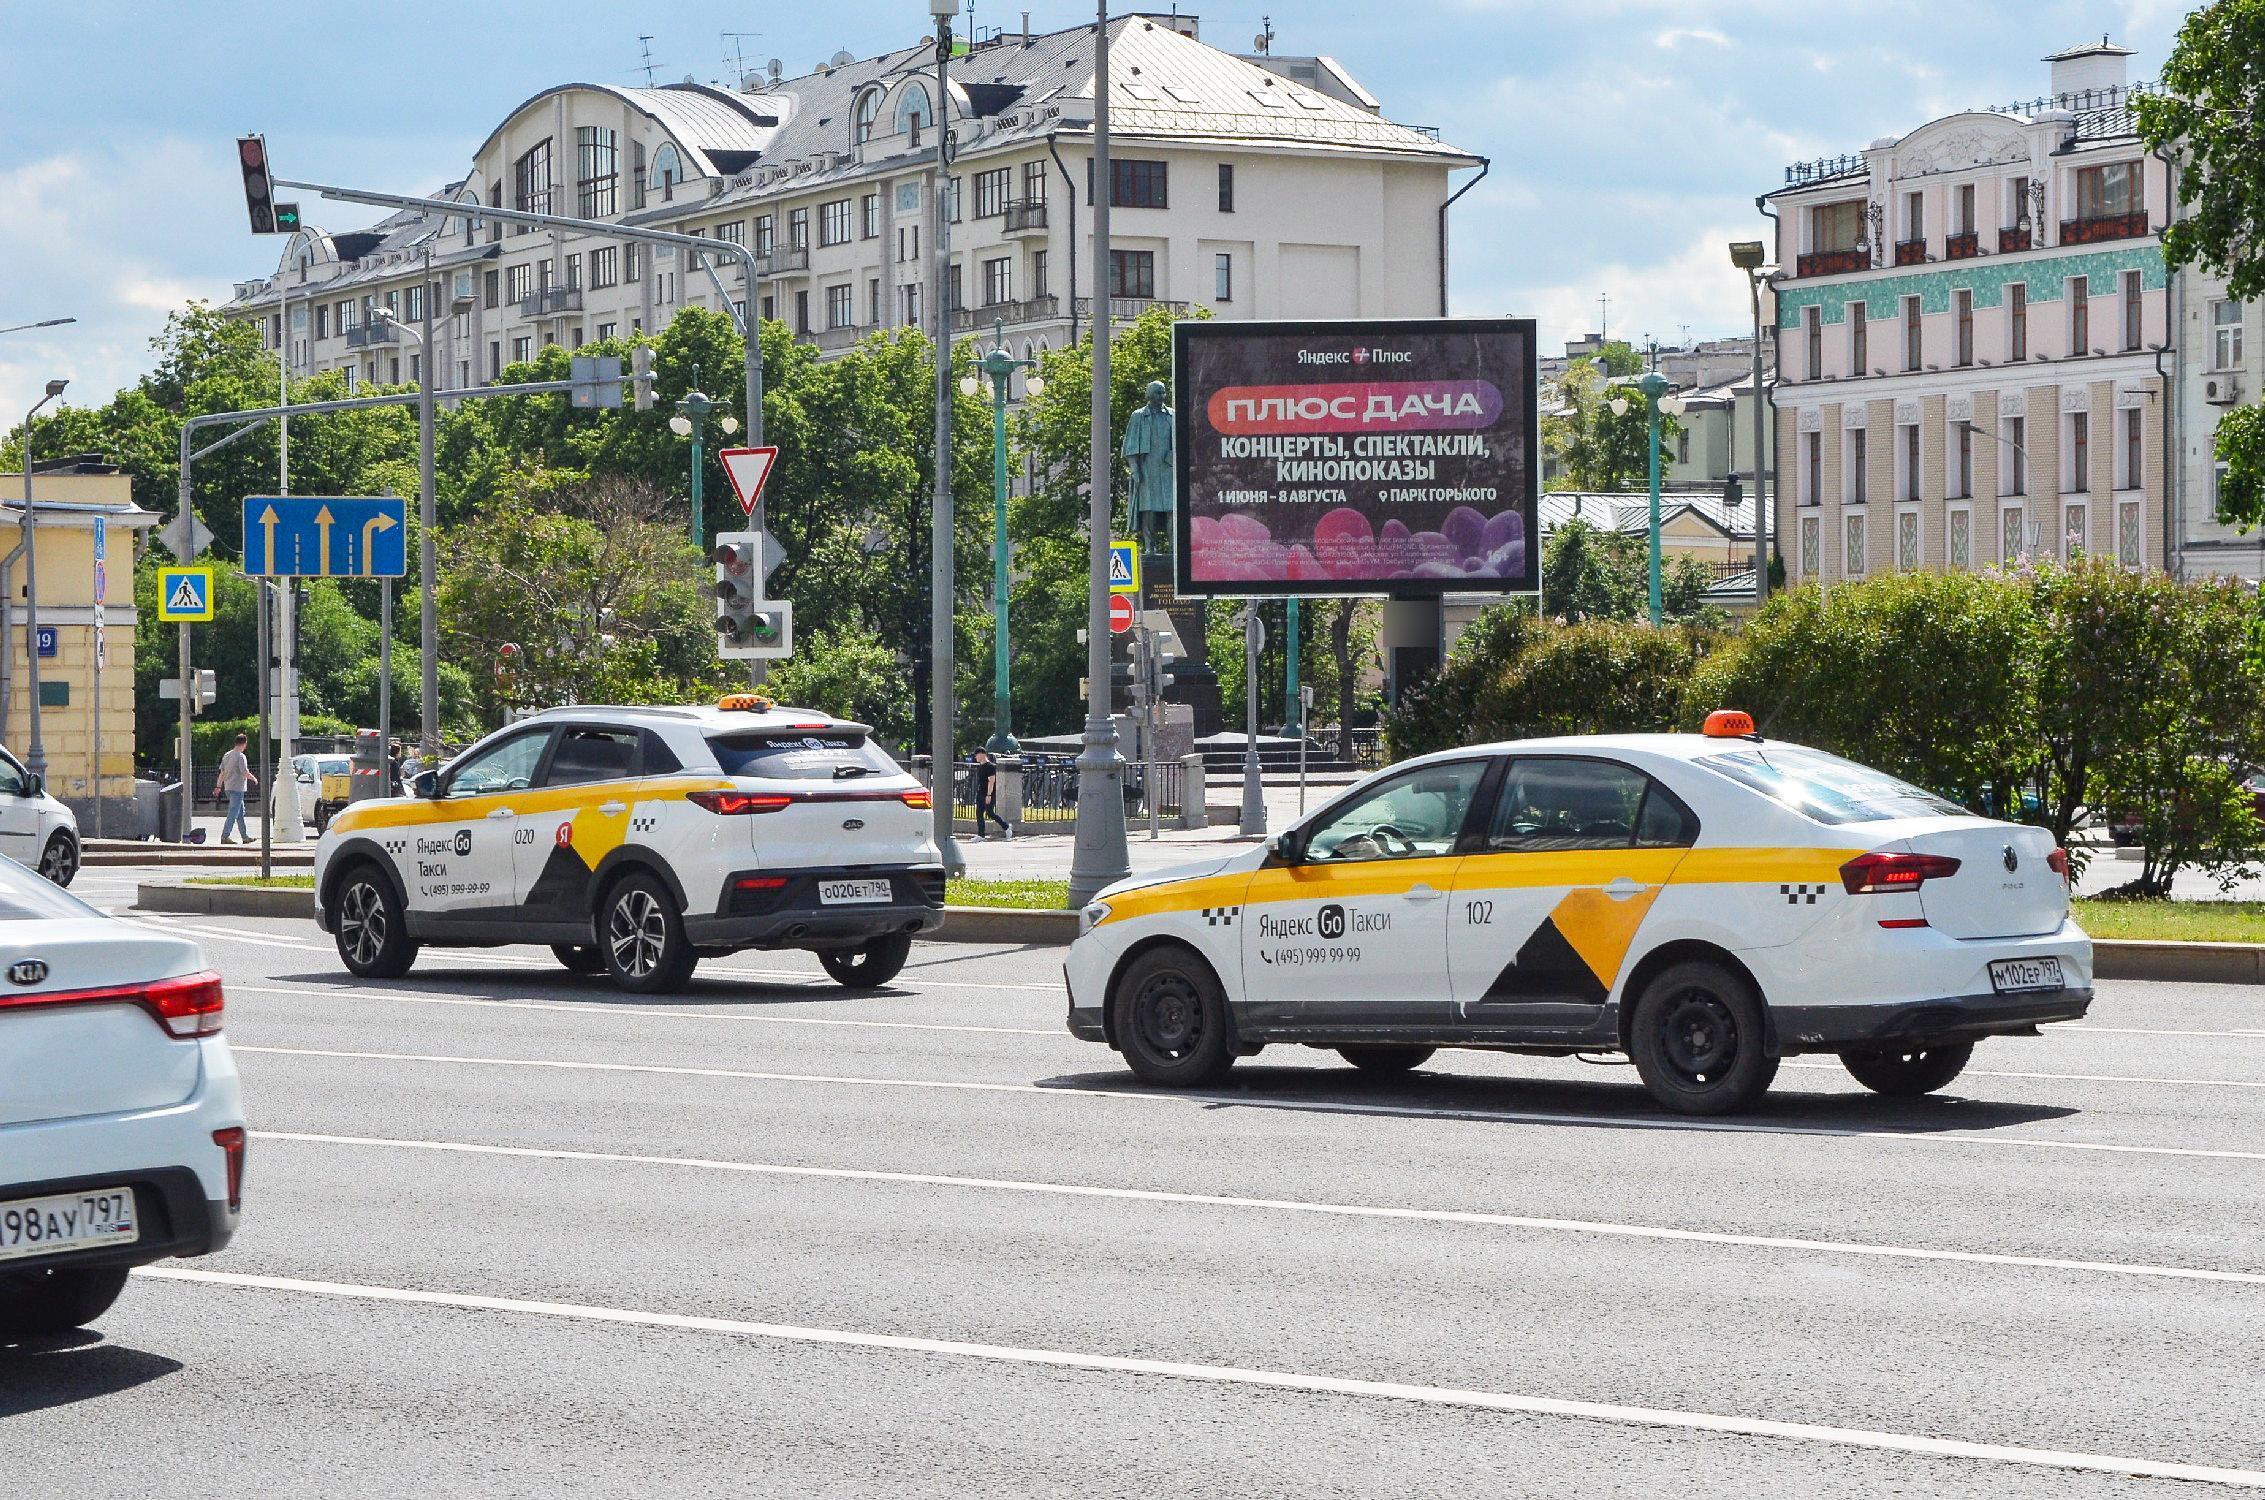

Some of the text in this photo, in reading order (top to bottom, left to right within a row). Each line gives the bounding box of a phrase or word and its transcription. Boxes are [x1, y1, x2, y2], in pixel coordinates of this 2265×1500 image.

[1297, 348, 1412, 365] Яндекс Плюс
[1227, 393, 1484, 422] ПЛЮС ДАЧА
[1220, 434, 1490, 461] КОНЦЕРТЫ, СПЕКТАКЛИ,
[1276, 459, 1435, 482] КИНОПОКАЗЫ
[1217, 490, 1224, 502] 1
[1225, 490, 1268, 503] ИЮНЯ
[1279, 490, 1288, 502] 8
[1289, 489, 1347, 503] АВГУСТА
[1390, 487, 1497, 502] ПАРК ГОРЬКОГО
[514, 829, 535, 845] 020
[559, 825, 570, 843] Я
[416, 832, 470, 855] Яндекс Go
[417, 861, 447, 877] Такси
[429, 883, 490, 897] (495) 999-99-99
[1465, 900, 1493, 925] 102
[1259, 908, 1391, 939] Яндекс Go Такси
[1275, 947, 1361, 966] (495) 999 99 99
[13, 963, 46, 981] KIA
[83, 1194, 123, 1224] 797
